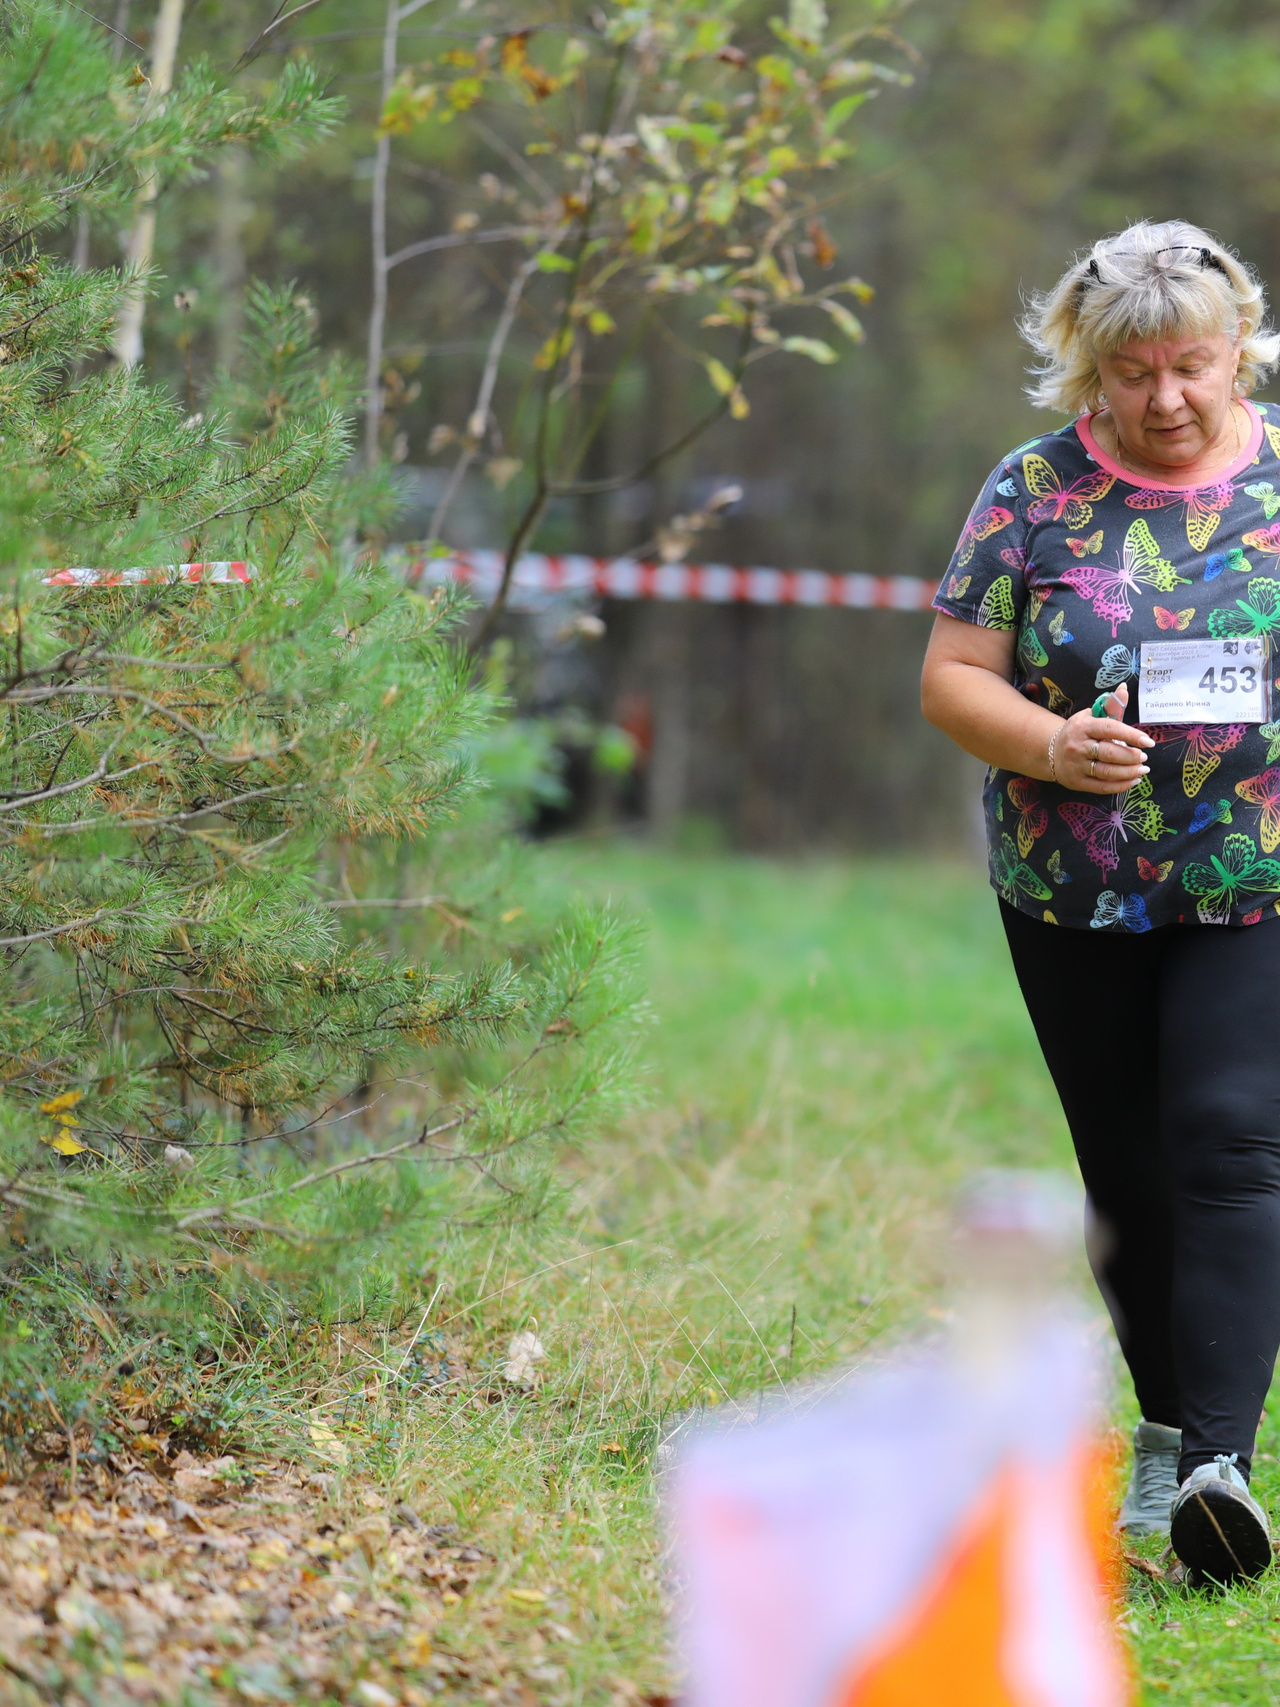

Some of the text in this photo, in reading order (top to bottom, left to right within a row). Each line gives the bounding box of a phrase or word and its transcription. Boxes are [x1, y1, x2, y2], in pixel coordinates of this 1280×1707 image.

[1146, 675, 1171, 683] 12:53
[1198, 666, 1258, 694] 453
[1145, 687, 1164, 695] Ж55
[1145, 700, 1211, 708] Гайденко Ирина
